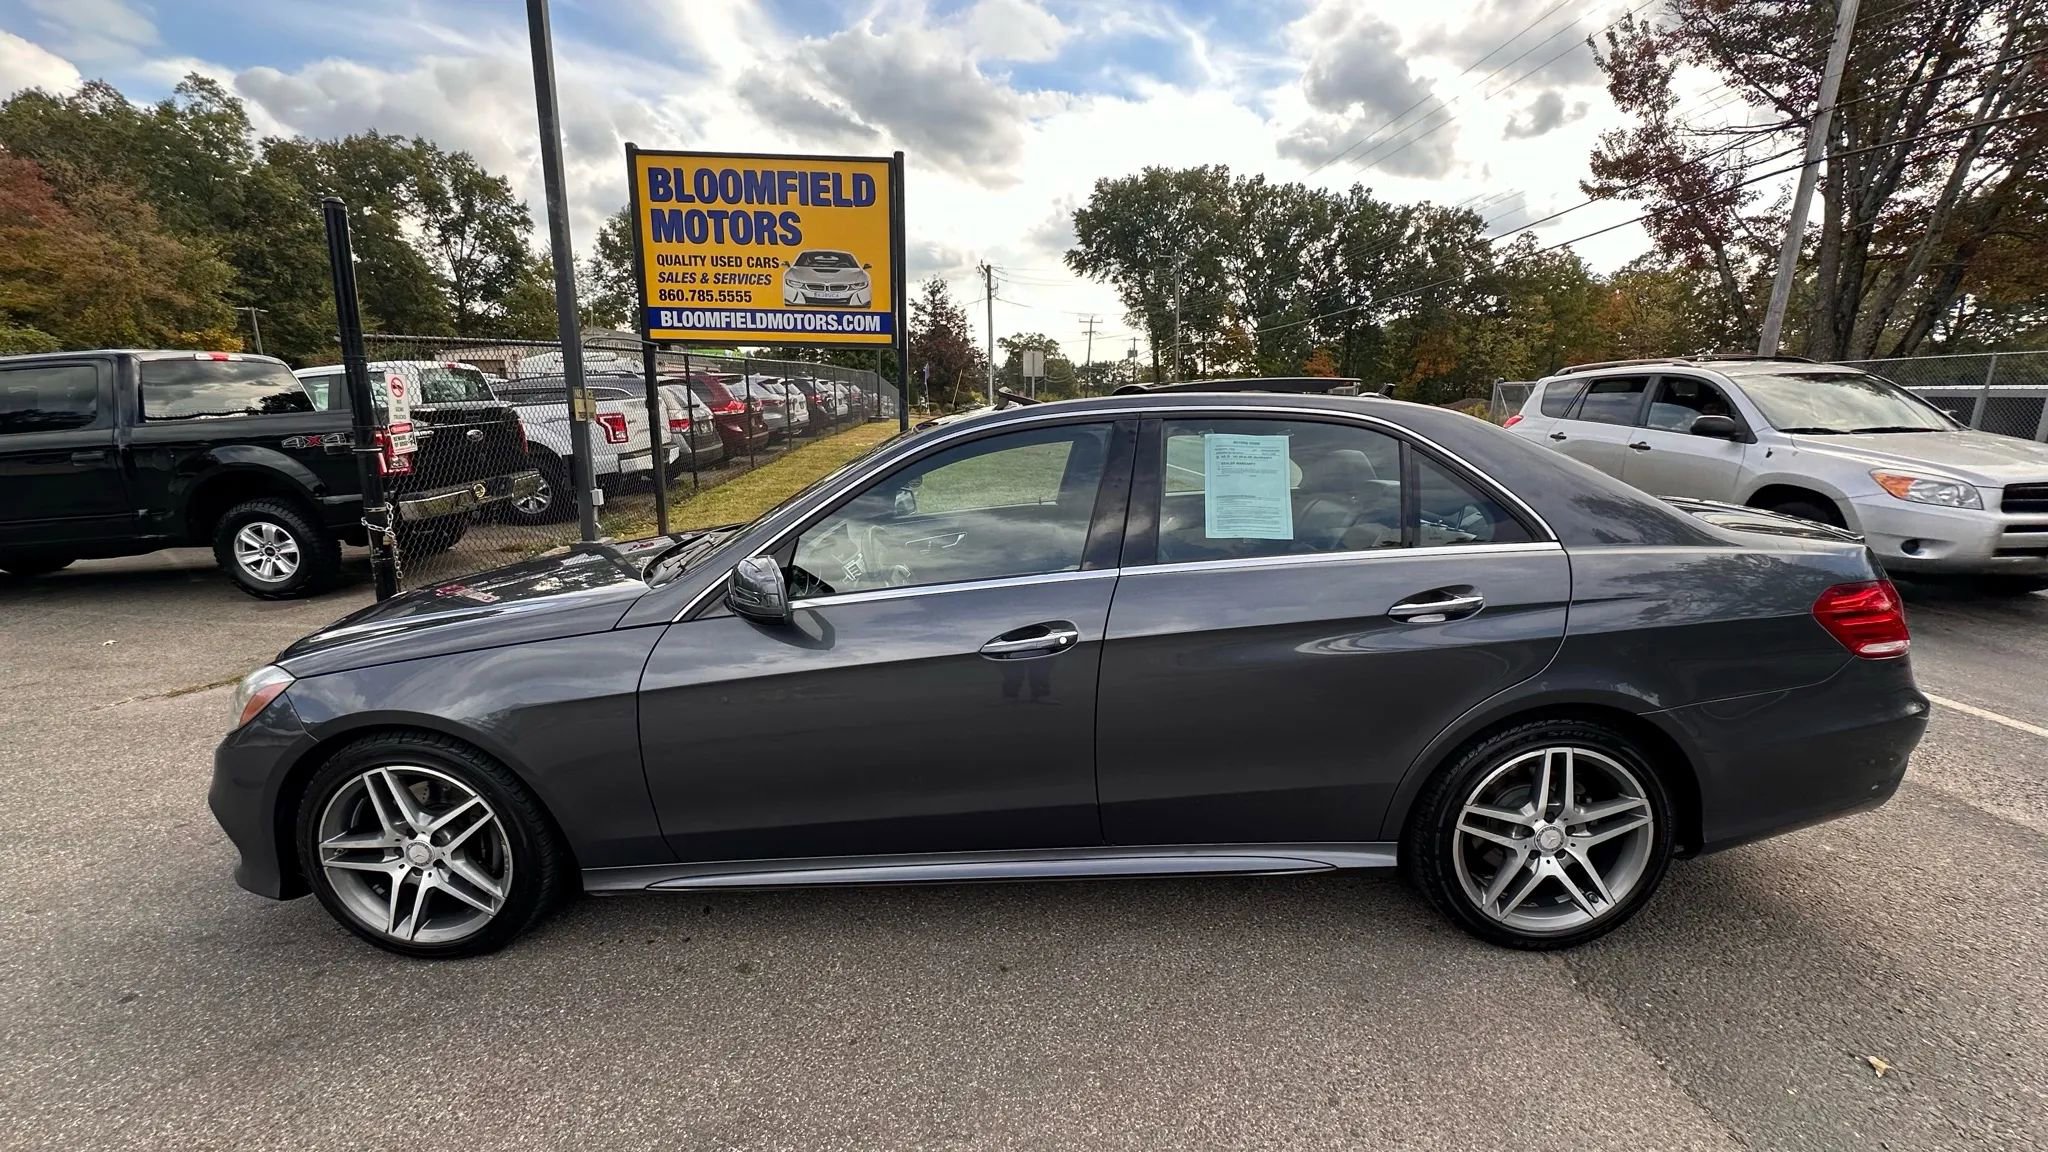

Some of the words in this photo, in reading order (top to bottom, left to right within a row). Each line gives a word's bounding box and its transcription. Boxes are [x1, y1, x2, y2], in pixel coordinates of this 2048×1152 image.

[648, 167, 876, 208] BLOOMFIELD
[650, 208, 803, 246] MOTORS
[656, 254, 706, 267] QUALITY
[710, 255, 743, 268] USED
[746, 256, 780, 269] CARS
[657, 272, 697, 284] SALES
[700, 273, 709, 284] &
[713, 273, 772, 286] SERVICES
[658, 289, 752, 303] 860.785.5555
[660, 310, 881, 332] BLOOMFIELDMOTORS.COM
